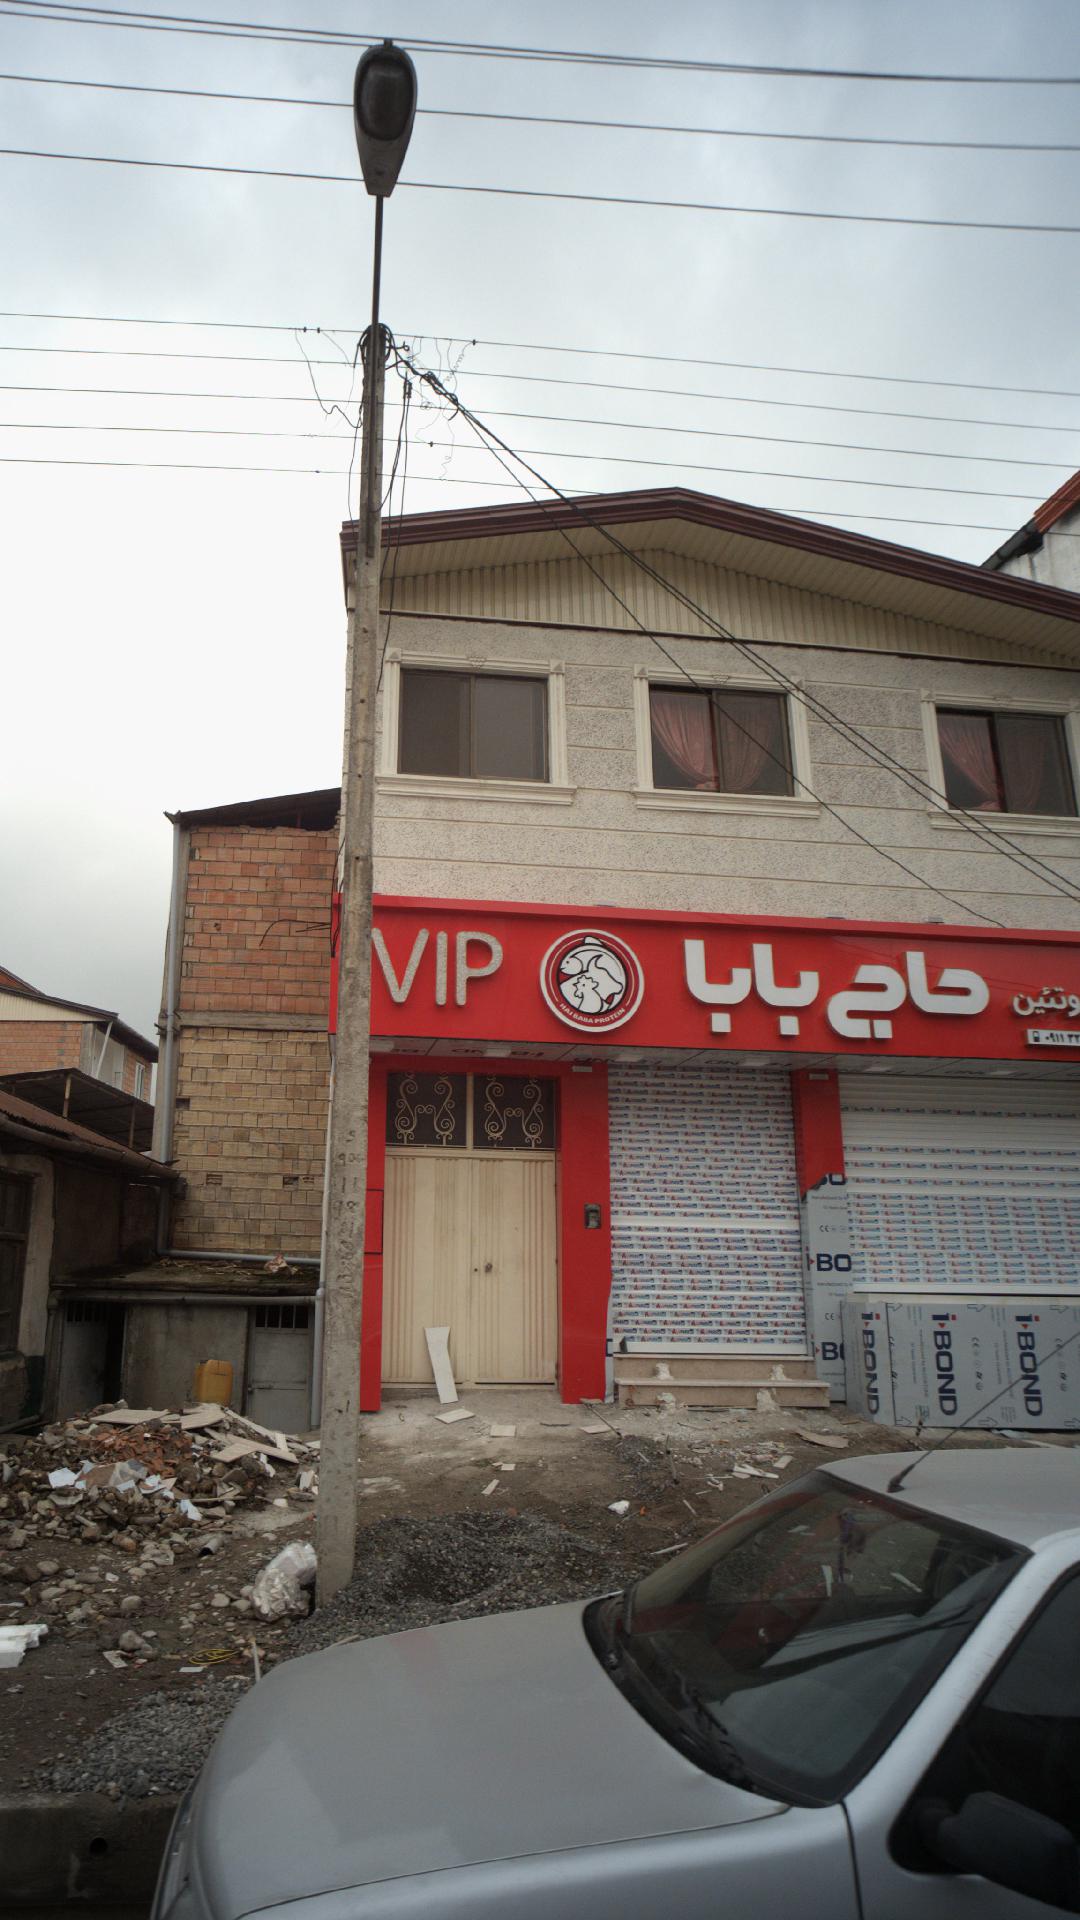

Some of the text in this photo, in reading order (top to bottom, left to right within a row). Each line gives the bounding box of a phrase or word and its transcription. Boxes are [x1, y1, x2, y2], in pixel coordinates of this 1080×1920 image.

[372, 927, 504, 1007] VIP
[684, 939, 990, 1040] حاج بابا
[573, 1013, 594, 1024] BABA
[594, 1008, 626, 1024] PROTEIN
